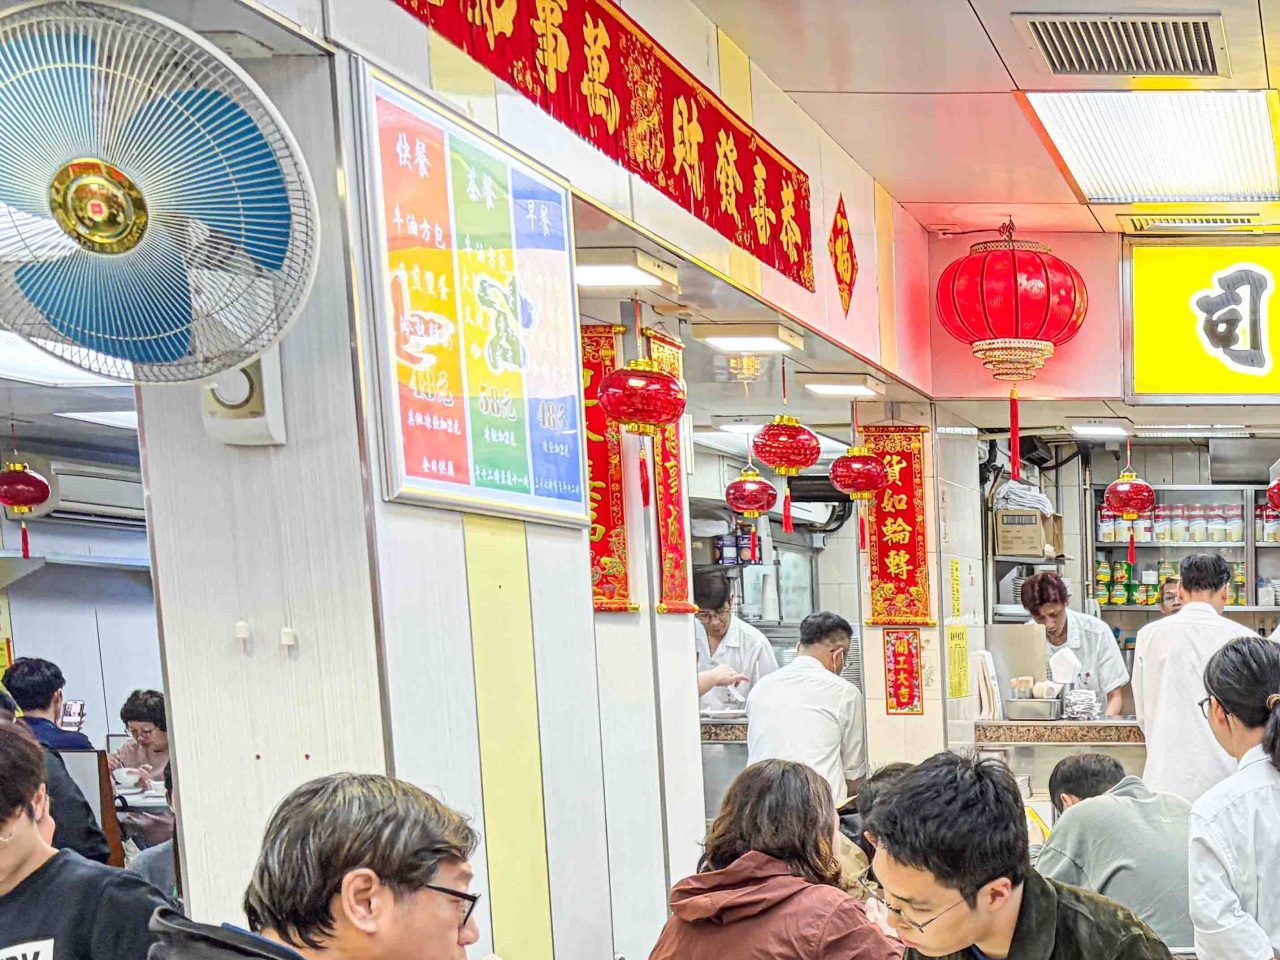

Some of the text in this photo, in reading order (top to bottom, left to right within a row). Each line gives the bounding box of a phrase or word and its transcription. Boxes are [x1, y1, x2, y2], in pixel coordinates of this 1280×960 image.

[395, 130, 432, 179] 快餐
[466, 167, 497, 212] 茶餐
[392, 202, 446, 250] 牛油方包
[526, 198, 553, 237] 早餐
[478, 384, 518, 421] 58元
[880, 454, 914, 581] 貨如輪轉
[894, 637, 910, 704] 開工大吉
